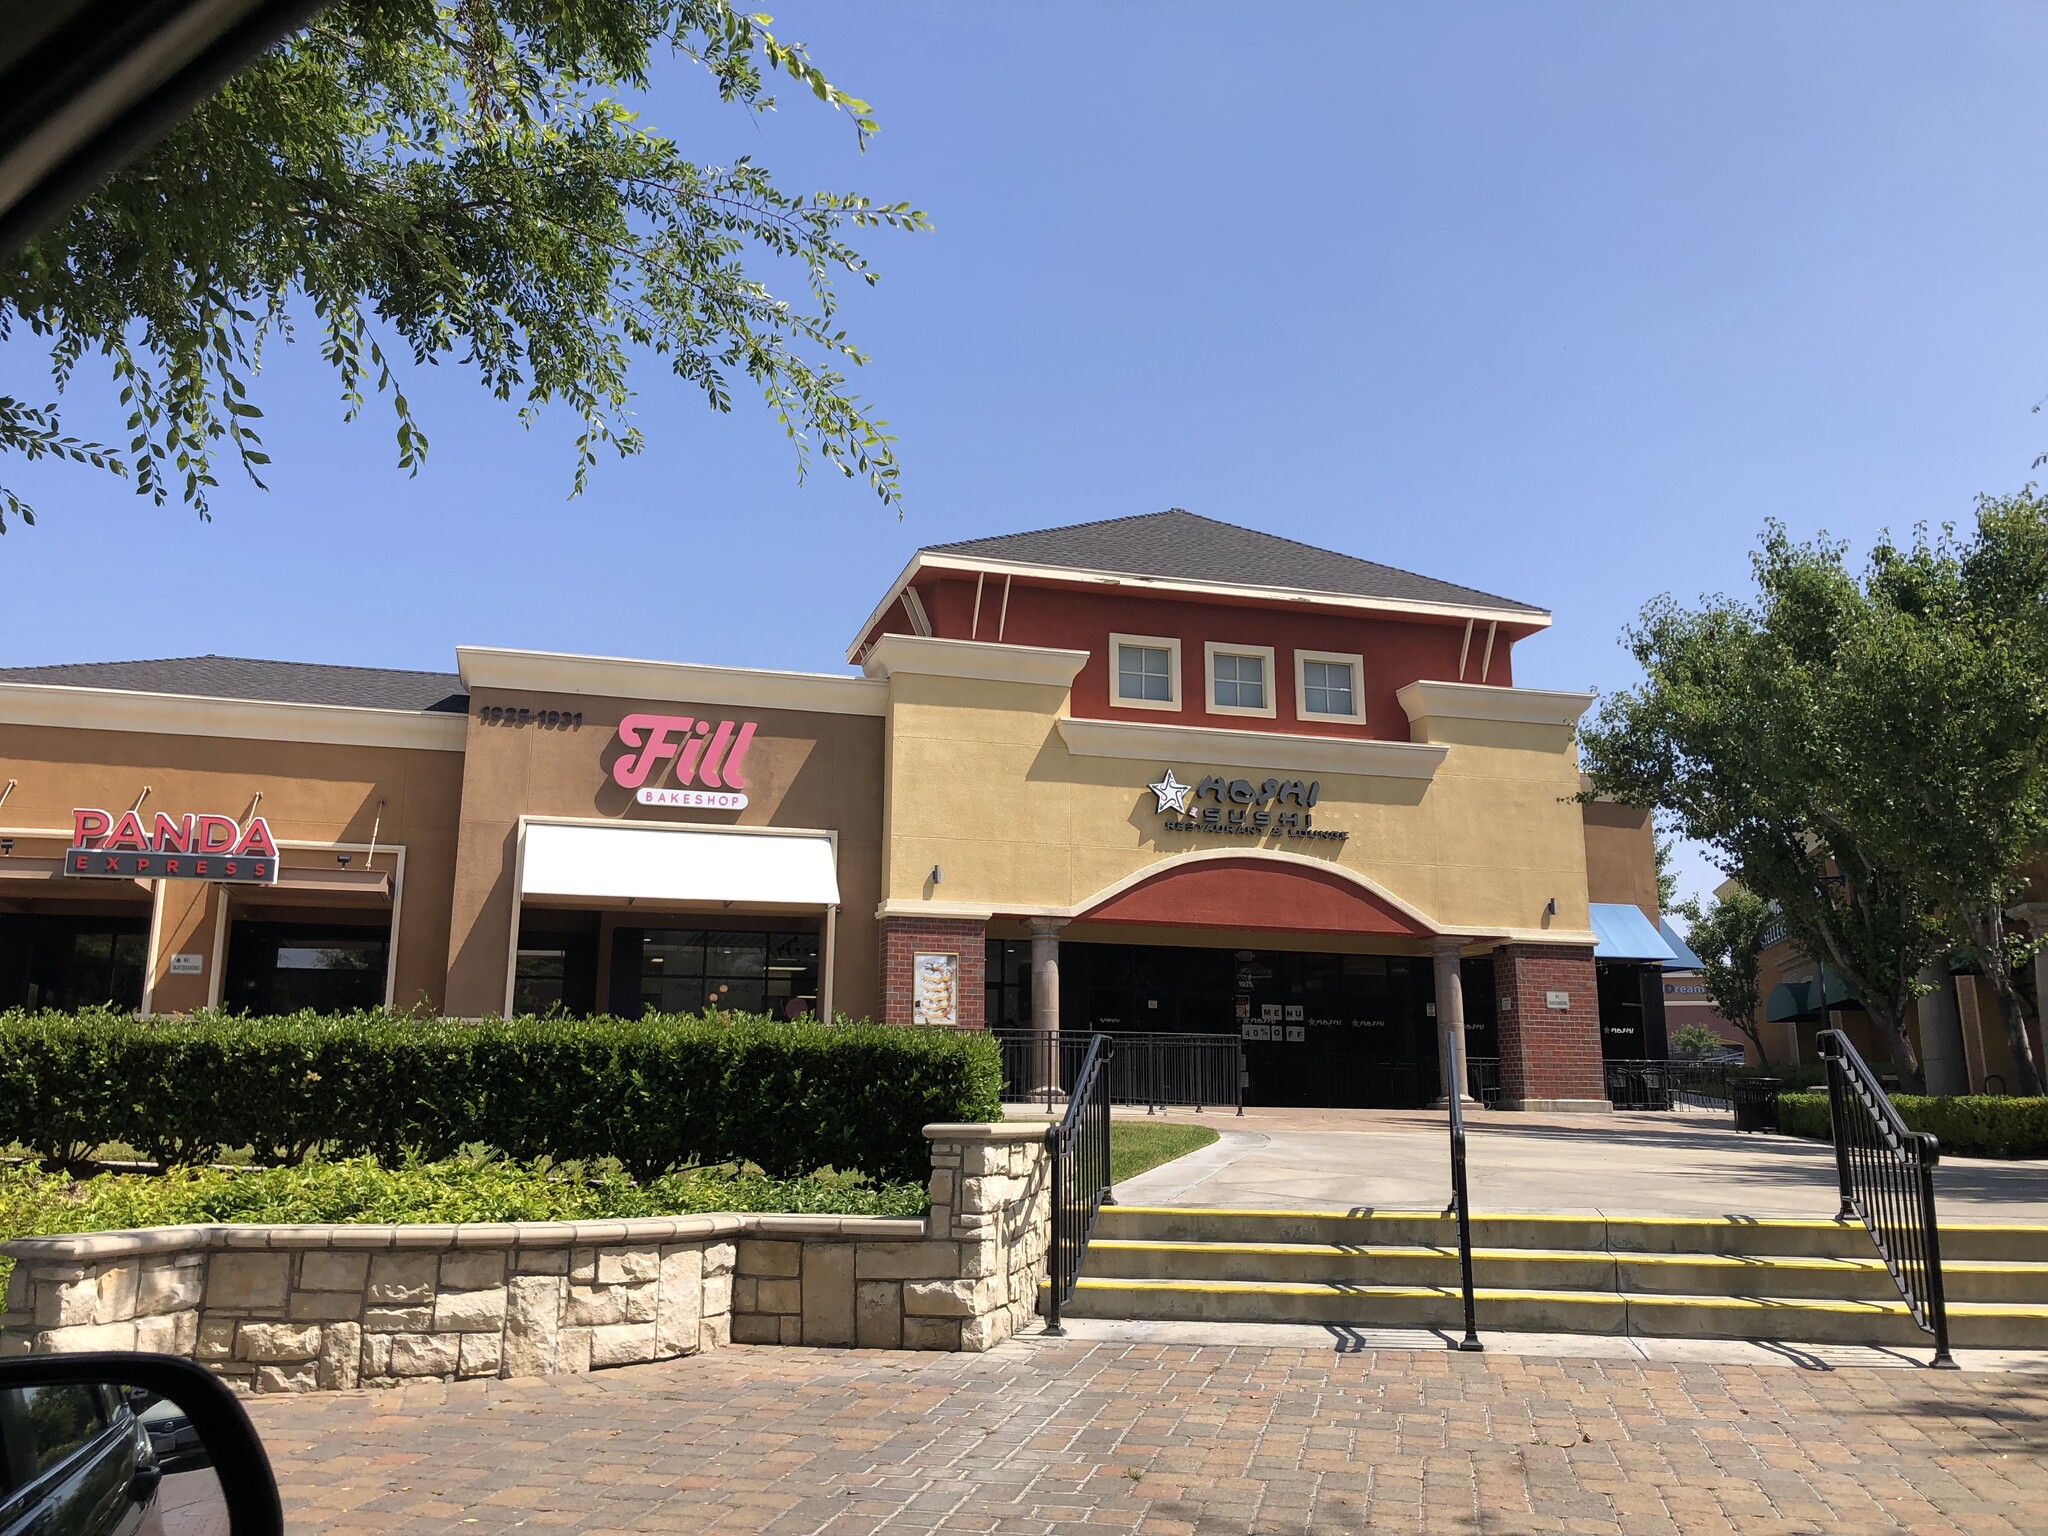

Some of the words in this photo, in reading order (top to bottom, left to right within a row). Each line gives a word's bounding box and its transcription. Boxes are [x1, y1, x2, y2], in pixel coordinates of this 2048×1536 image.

[480, 705, 583, 727] 1925-1931
[613, 713, 758, 789] Fill
[645, 791, 739, 807] BAKESHOP
[1203, 808, 1312, 828] SUSHI
[71, 808, 280, 858] PANDA
[1165, 821, 1264, 836] RESTAURANT
[1271, 827, 1283, 836] &
[1288, 829, 1349, 840] LOUNGE
[75, 855, 266, 877] EXPRESS
[1263, 1009, 1302, 1018] MENU
[1245, 1027, 1269, 1037] 40%
[1274, 1029, 1303, 1038] OFF
